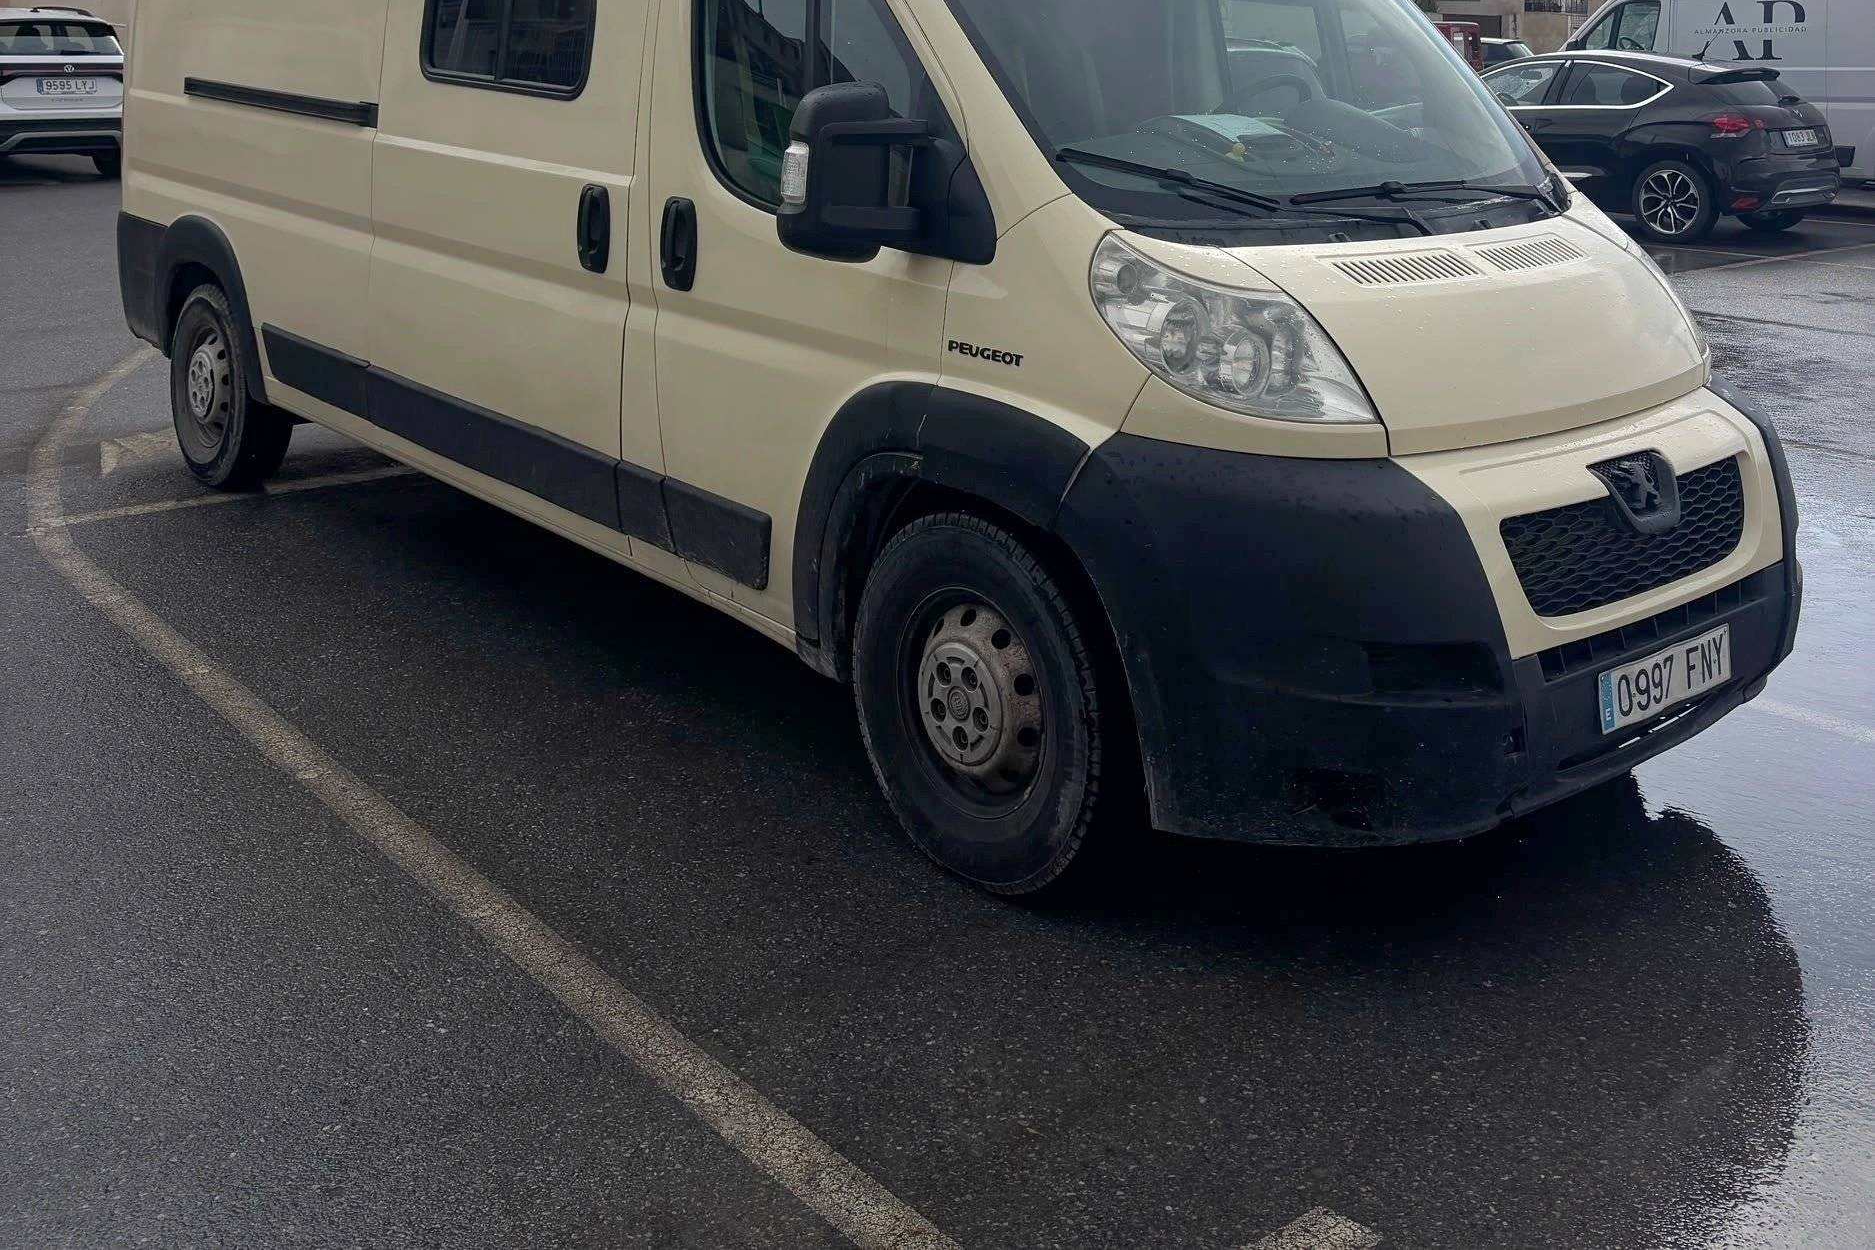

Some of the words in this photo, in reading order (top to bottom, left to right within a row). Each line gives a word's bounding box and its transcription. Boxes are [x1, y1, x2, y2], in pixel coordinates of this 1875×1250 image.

[1694, 27, 1748, 35] ALMANZORA
[1752, 25, 1807, 33] PUBLICIDAD
[45, 80, 72, 91] 9595
[75, 80, 95, 90] LYJ
[947, 339, 1025, 367] PEUGEOT
[1605, 707, 1612, 721] E
[1617, 654, 1674, 717] 0997
[1685, 633, 1724, 690] FNY
